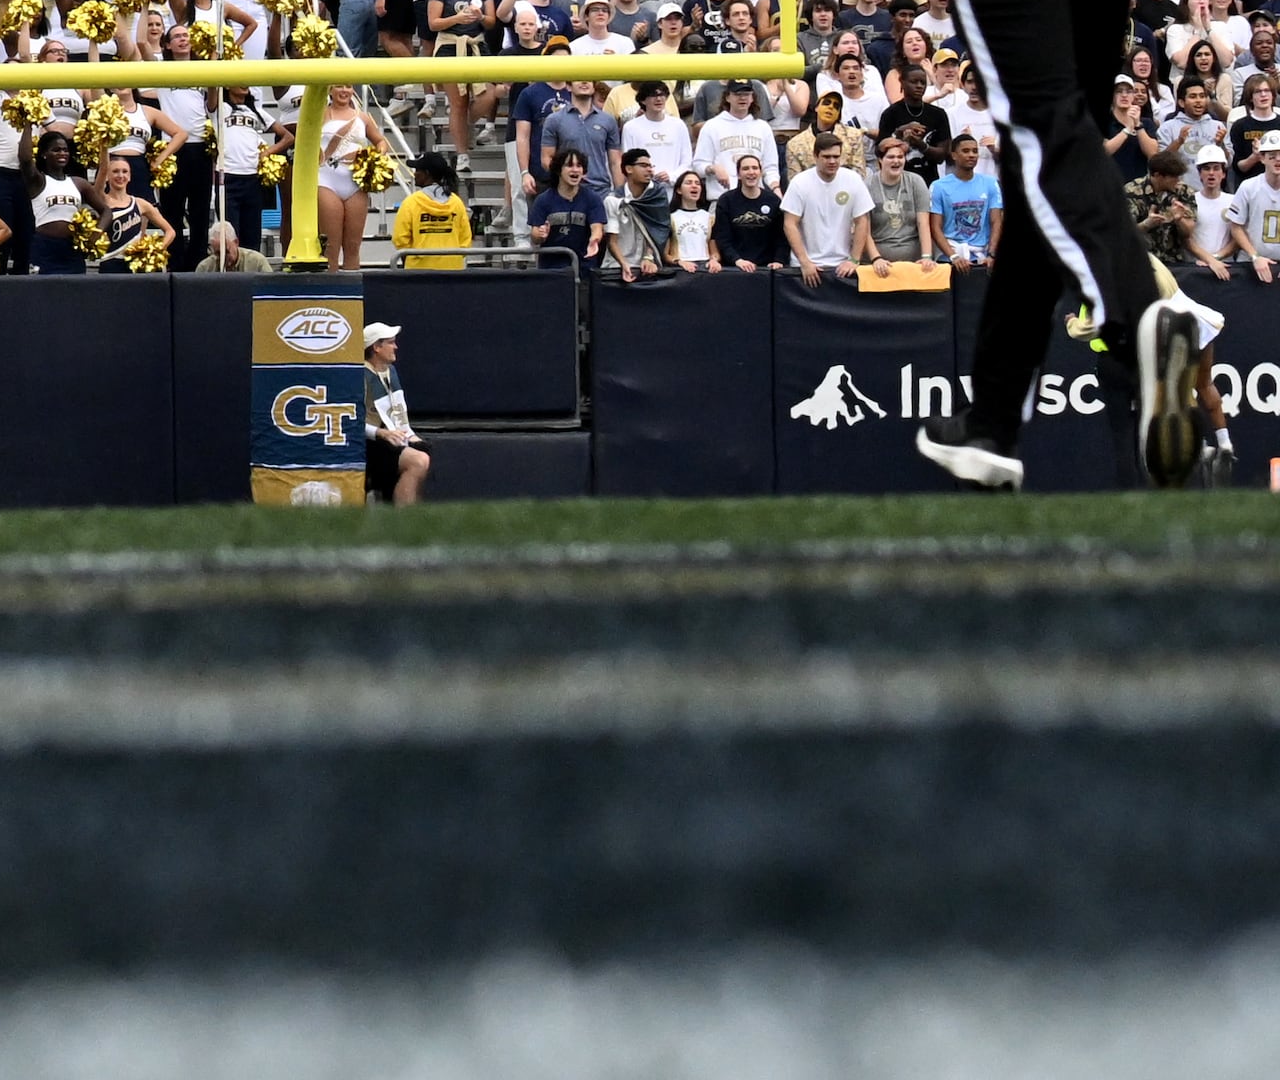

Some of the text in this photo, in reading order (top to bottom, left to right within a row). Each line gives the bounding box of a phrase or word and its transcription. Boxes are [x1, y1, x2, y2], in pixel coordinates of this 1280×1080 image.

[420, 212, 457, 224] BEST
[290, 320, 341, 335] ACC
[900, 362, 1280, 418] Insc QQ
[270, 385, 357, 446] GT
